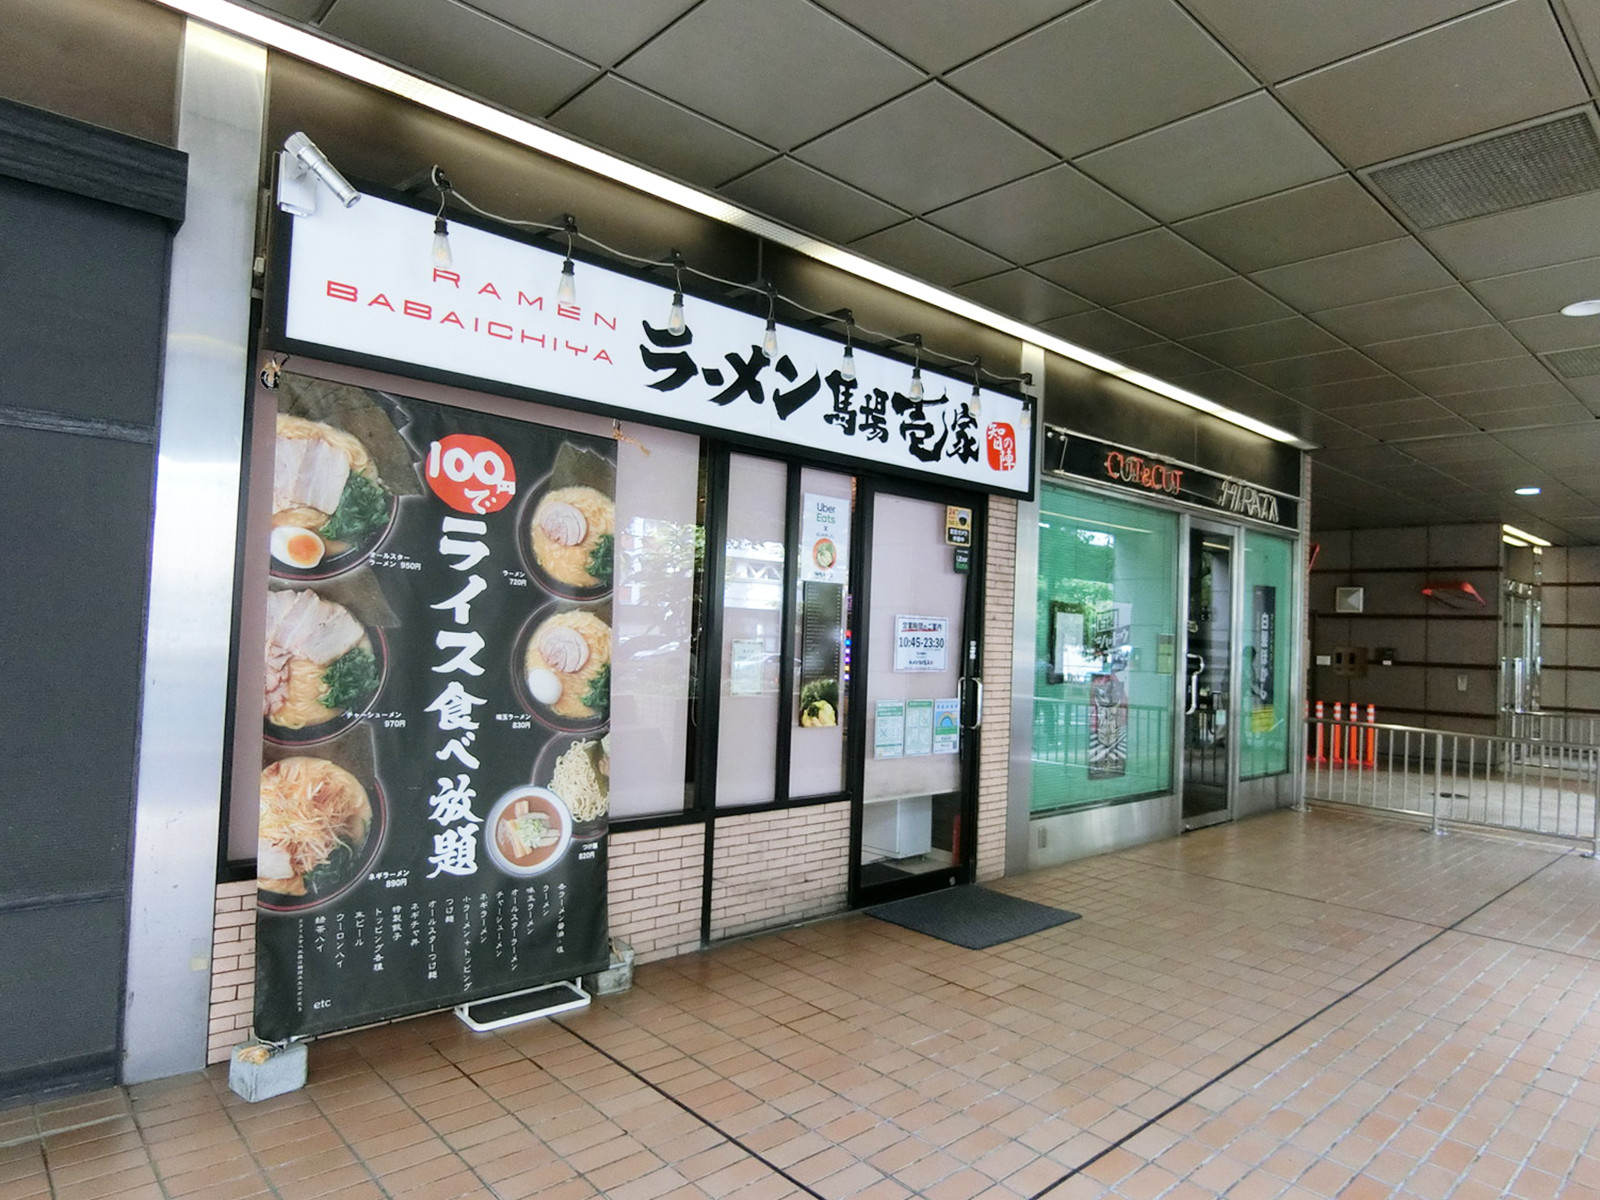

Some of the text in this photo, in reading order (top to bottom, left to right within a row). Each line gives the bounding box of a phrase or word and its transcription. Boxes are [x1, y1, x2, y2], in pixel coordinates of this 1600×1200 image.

[432, 267, 617, 331] RAMEN
[326, 280, 613, 365] BABAICHIYA
[429, 440, 516, 495] 100円
[464, 487, 497, 515] で
[815, 512, 836, 524] Eats
[816, 502, 836, 514] Uber
[1219, 480, 1280, 523] HIRATA
[368, 559, 397, 568] ラーメン
[502, 569, 526, 578] ラーメン
[423, 516, 490, 879] ライス食べ放題
[384, 719, 406, 728] 970円
[368, 869, 410, 881] ネギラーメン
[479, 893, 488, 944] ネギラーメン
[542, 884, 551, 917] ラーメン
[335, 913, 346, 969] ウーロンハイ
[354, 911, 366, 948] 生ビール
[373, 908, 385, 972] トッピング各種
[495, 890, 504, 958] チャーシューメン
[510, 888, 519, 972] オールスターラーメン
[313, 998, 332, 1010] etc
